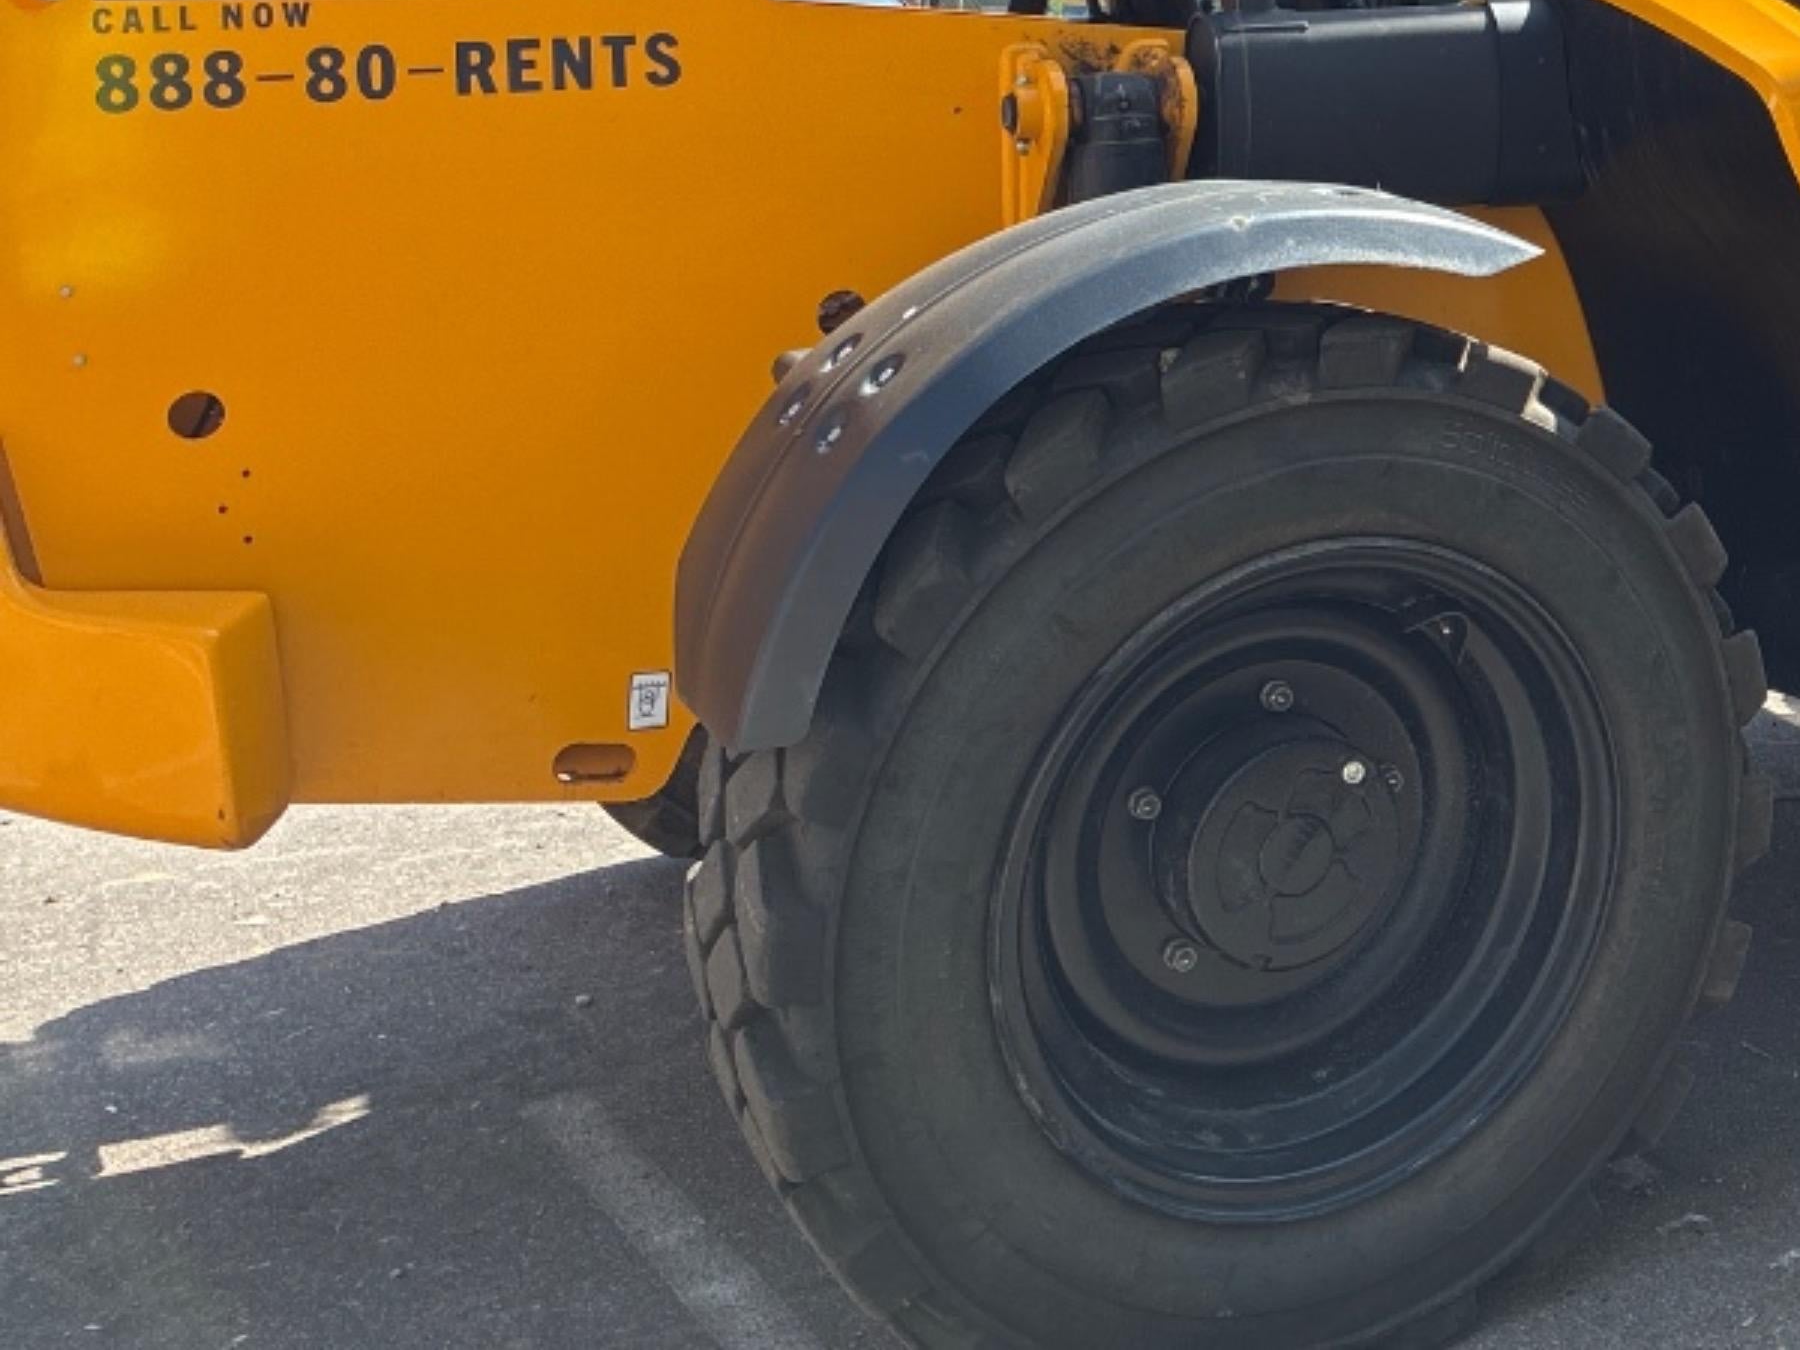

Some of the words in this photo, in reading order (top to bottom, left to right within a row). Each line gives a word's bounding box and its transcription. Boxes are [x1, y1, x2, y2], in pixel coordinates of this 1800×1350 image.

[92, 4, 198, 35] CALL
[221, 2, 312, 30] NOW
[94, 32, 682, 114] 888-80-RENTS
